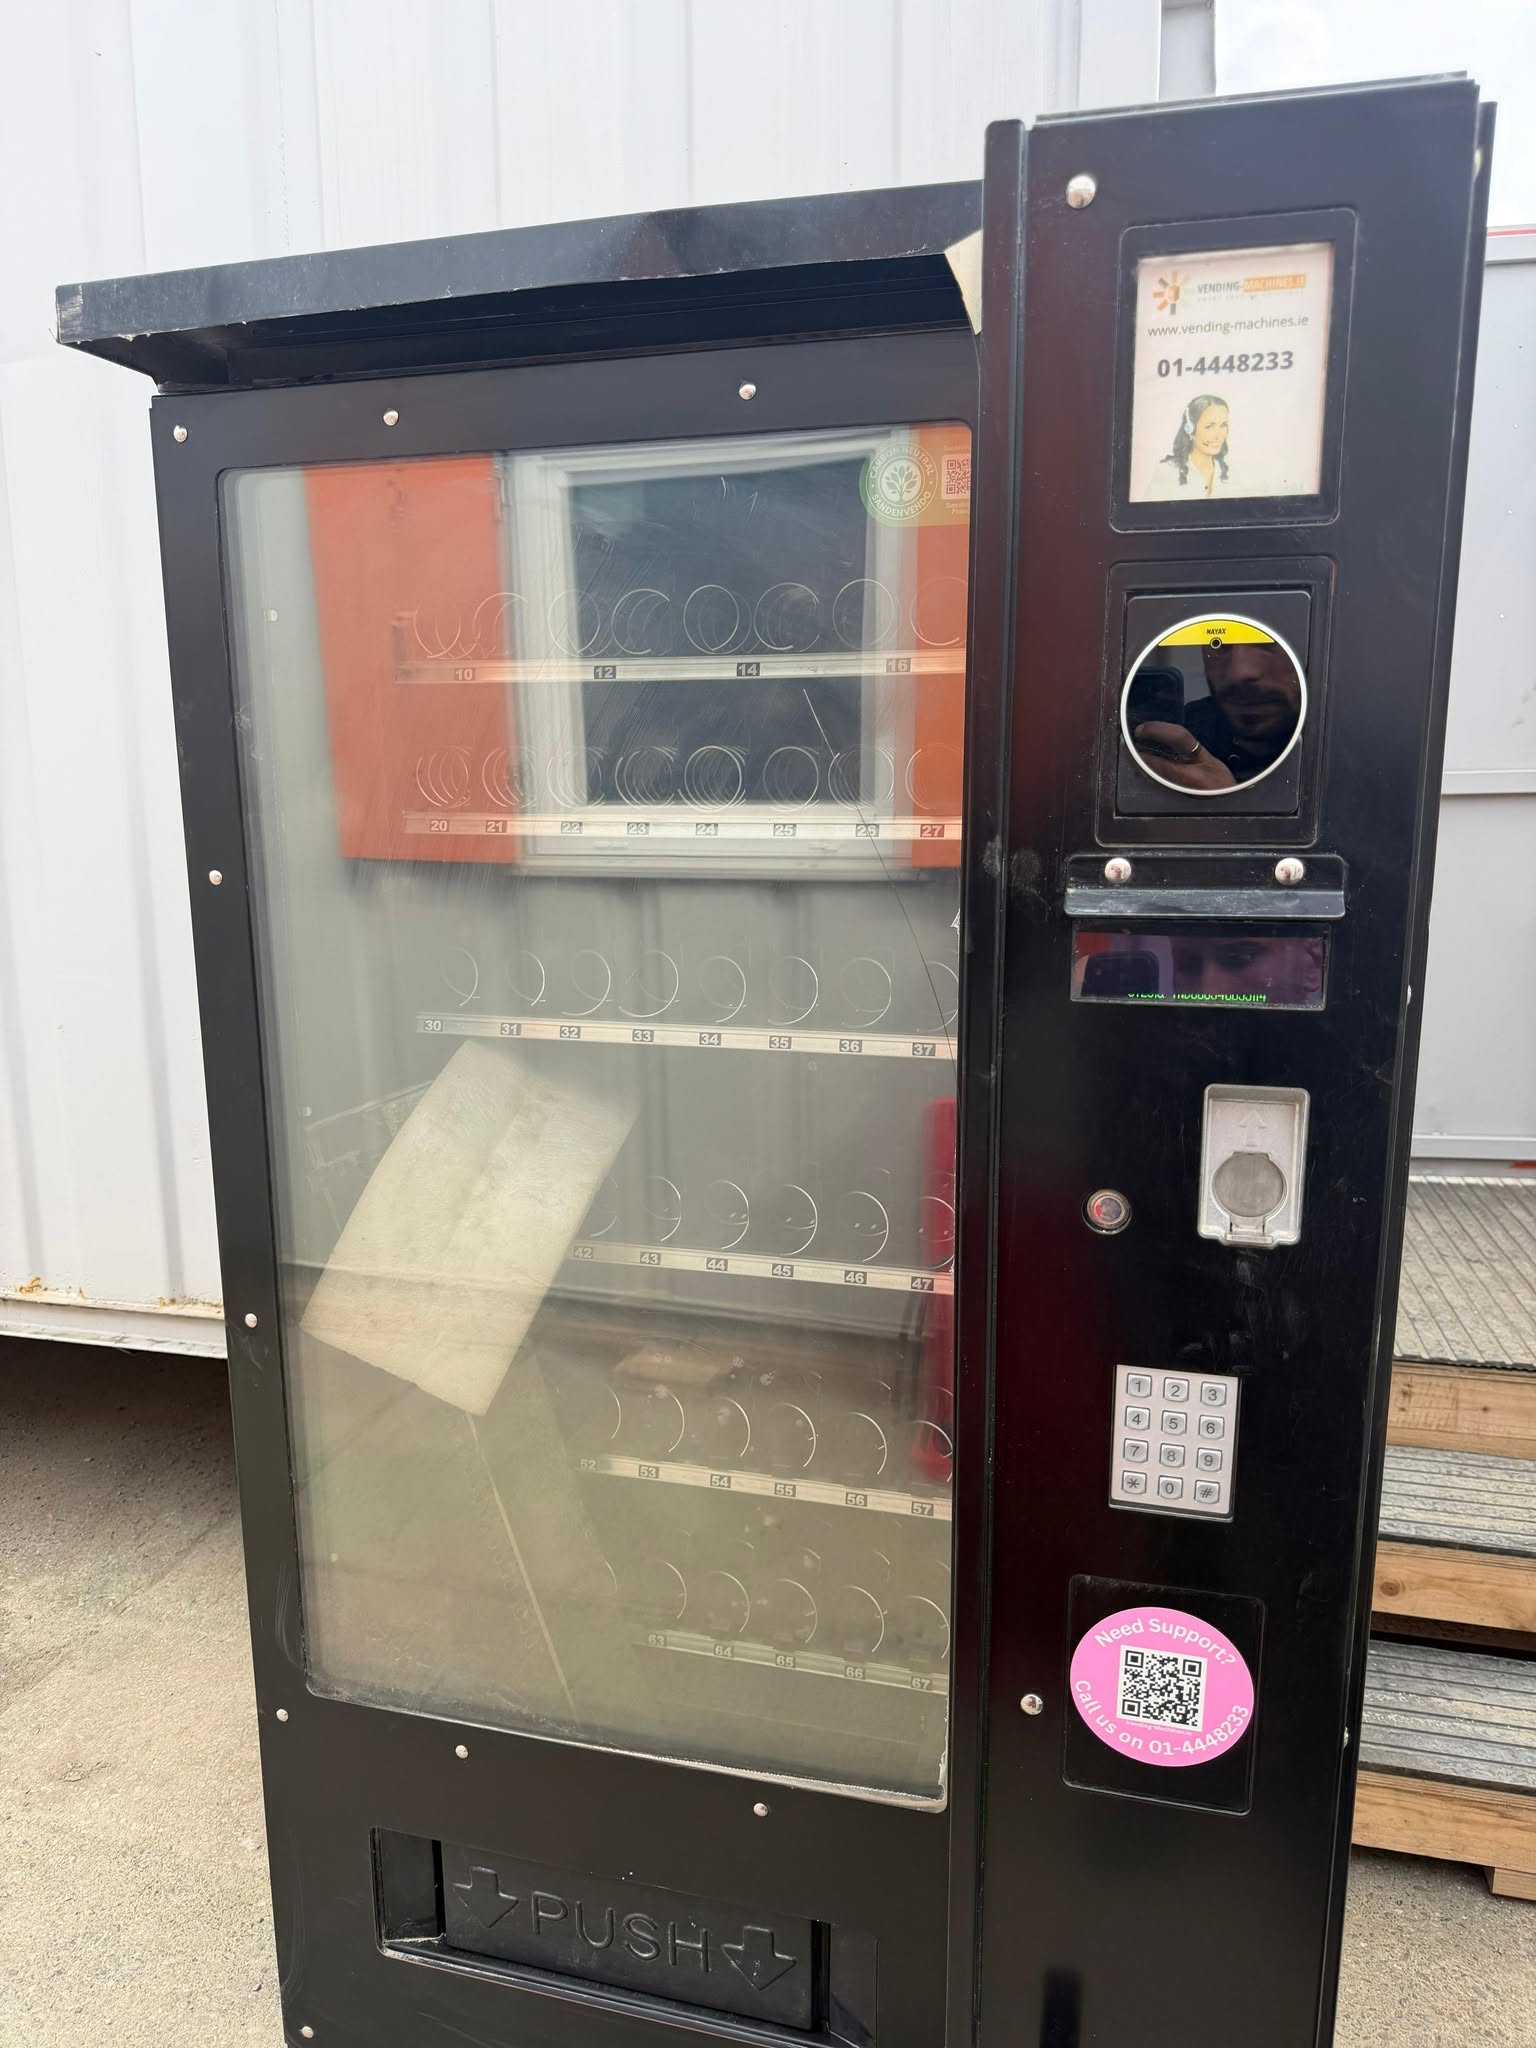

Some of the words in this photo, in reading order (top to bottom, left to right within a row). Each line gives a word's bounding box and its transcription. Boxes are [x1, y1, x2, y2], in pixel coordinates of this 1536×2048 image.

[1147, 315, 1309, 336] www.vending-machines.ie
[1157, 351, 1294, 378] 01-4448233
[455, 668, 474, 681] 10
[595, 666, 615, 680] 12
[738, 663, 758, 677] 14
[887, 659, 909, 673] 16
[430, 820, 449, 833] 20
[487, 820, 505, 833] 21
[562, 821, 581, 834] 22
[628, 822, 647, 836] 23
[696, 823, 717, 836] 24
[774, 824, 794, 837] 25
[858, 823, 877, 838] 26
[922, 824, 942, 838] 27
[424, 1020, 442, 1032] 30
[502, 1023, 520, 1035] 31
[561, 1026, 580, 1038] 32
[633, 1029, 652, 1042] 33
[701, 1034, 720, 1046] 34
[771, 1037, 790, 1050] 35
[841, 1040, 860, 1053] 36
[914, 1044, 934, 1056] 37
[575, 1246, 593, 1259] 42
[641, 1252, 659, 1265] 43
[707, 1258, 726, 1271] 44
[774, 1264, 792, 1277] 45
[846, 1271, 865, 1284] 46
[913, 1277, 932, 1290] 47
[1135, 1381, 1142, 1392] 1
[1171, 1385, 1180, 1397] 2
[1208, 1389, 1218, 1401] 3
[1132, 1413, 1141, 1425] 4
[1169, 1418, 1178, 1430] 5
[1206, 1422, 1216, 1434] 6
[1131, 1446, 1140, 1456] 7
[1167, 1451, 1176, 1462] 8
[1204, 1455, 1214, 1466] 9
[580, 1459, 597, 1471] 52
[640, 1465, 657, 1478] 53
[711, 1475, 730, 1488] 54
[776, 1483, 795, 1496] 55
[847, 1492, 866, 1506] 56
[913, 1502, 932, 1515] 57
[1165, 1483, 1174, 1494] 0
[1094, 1618, 1145, 1648] Need
[1149, 1618, 1237, 1665] Support?
[648, 1634, 666, 1647] 63
[715, 1645, 733, 1658] 64
[777, 1655, 795, 1668] 65
[846, 1666, 865, 1679] 66
[912, 1677, 931, 1690] 67
[1075, 1680, 1102, 1714] Call
[1095, 1714, 1117, 1734] us
[1119, 1732, 1143, 1750] on
[1149, 1704, 1249, 1756] 01-4448233
[531, 1891, 712, 1973] PUSH
